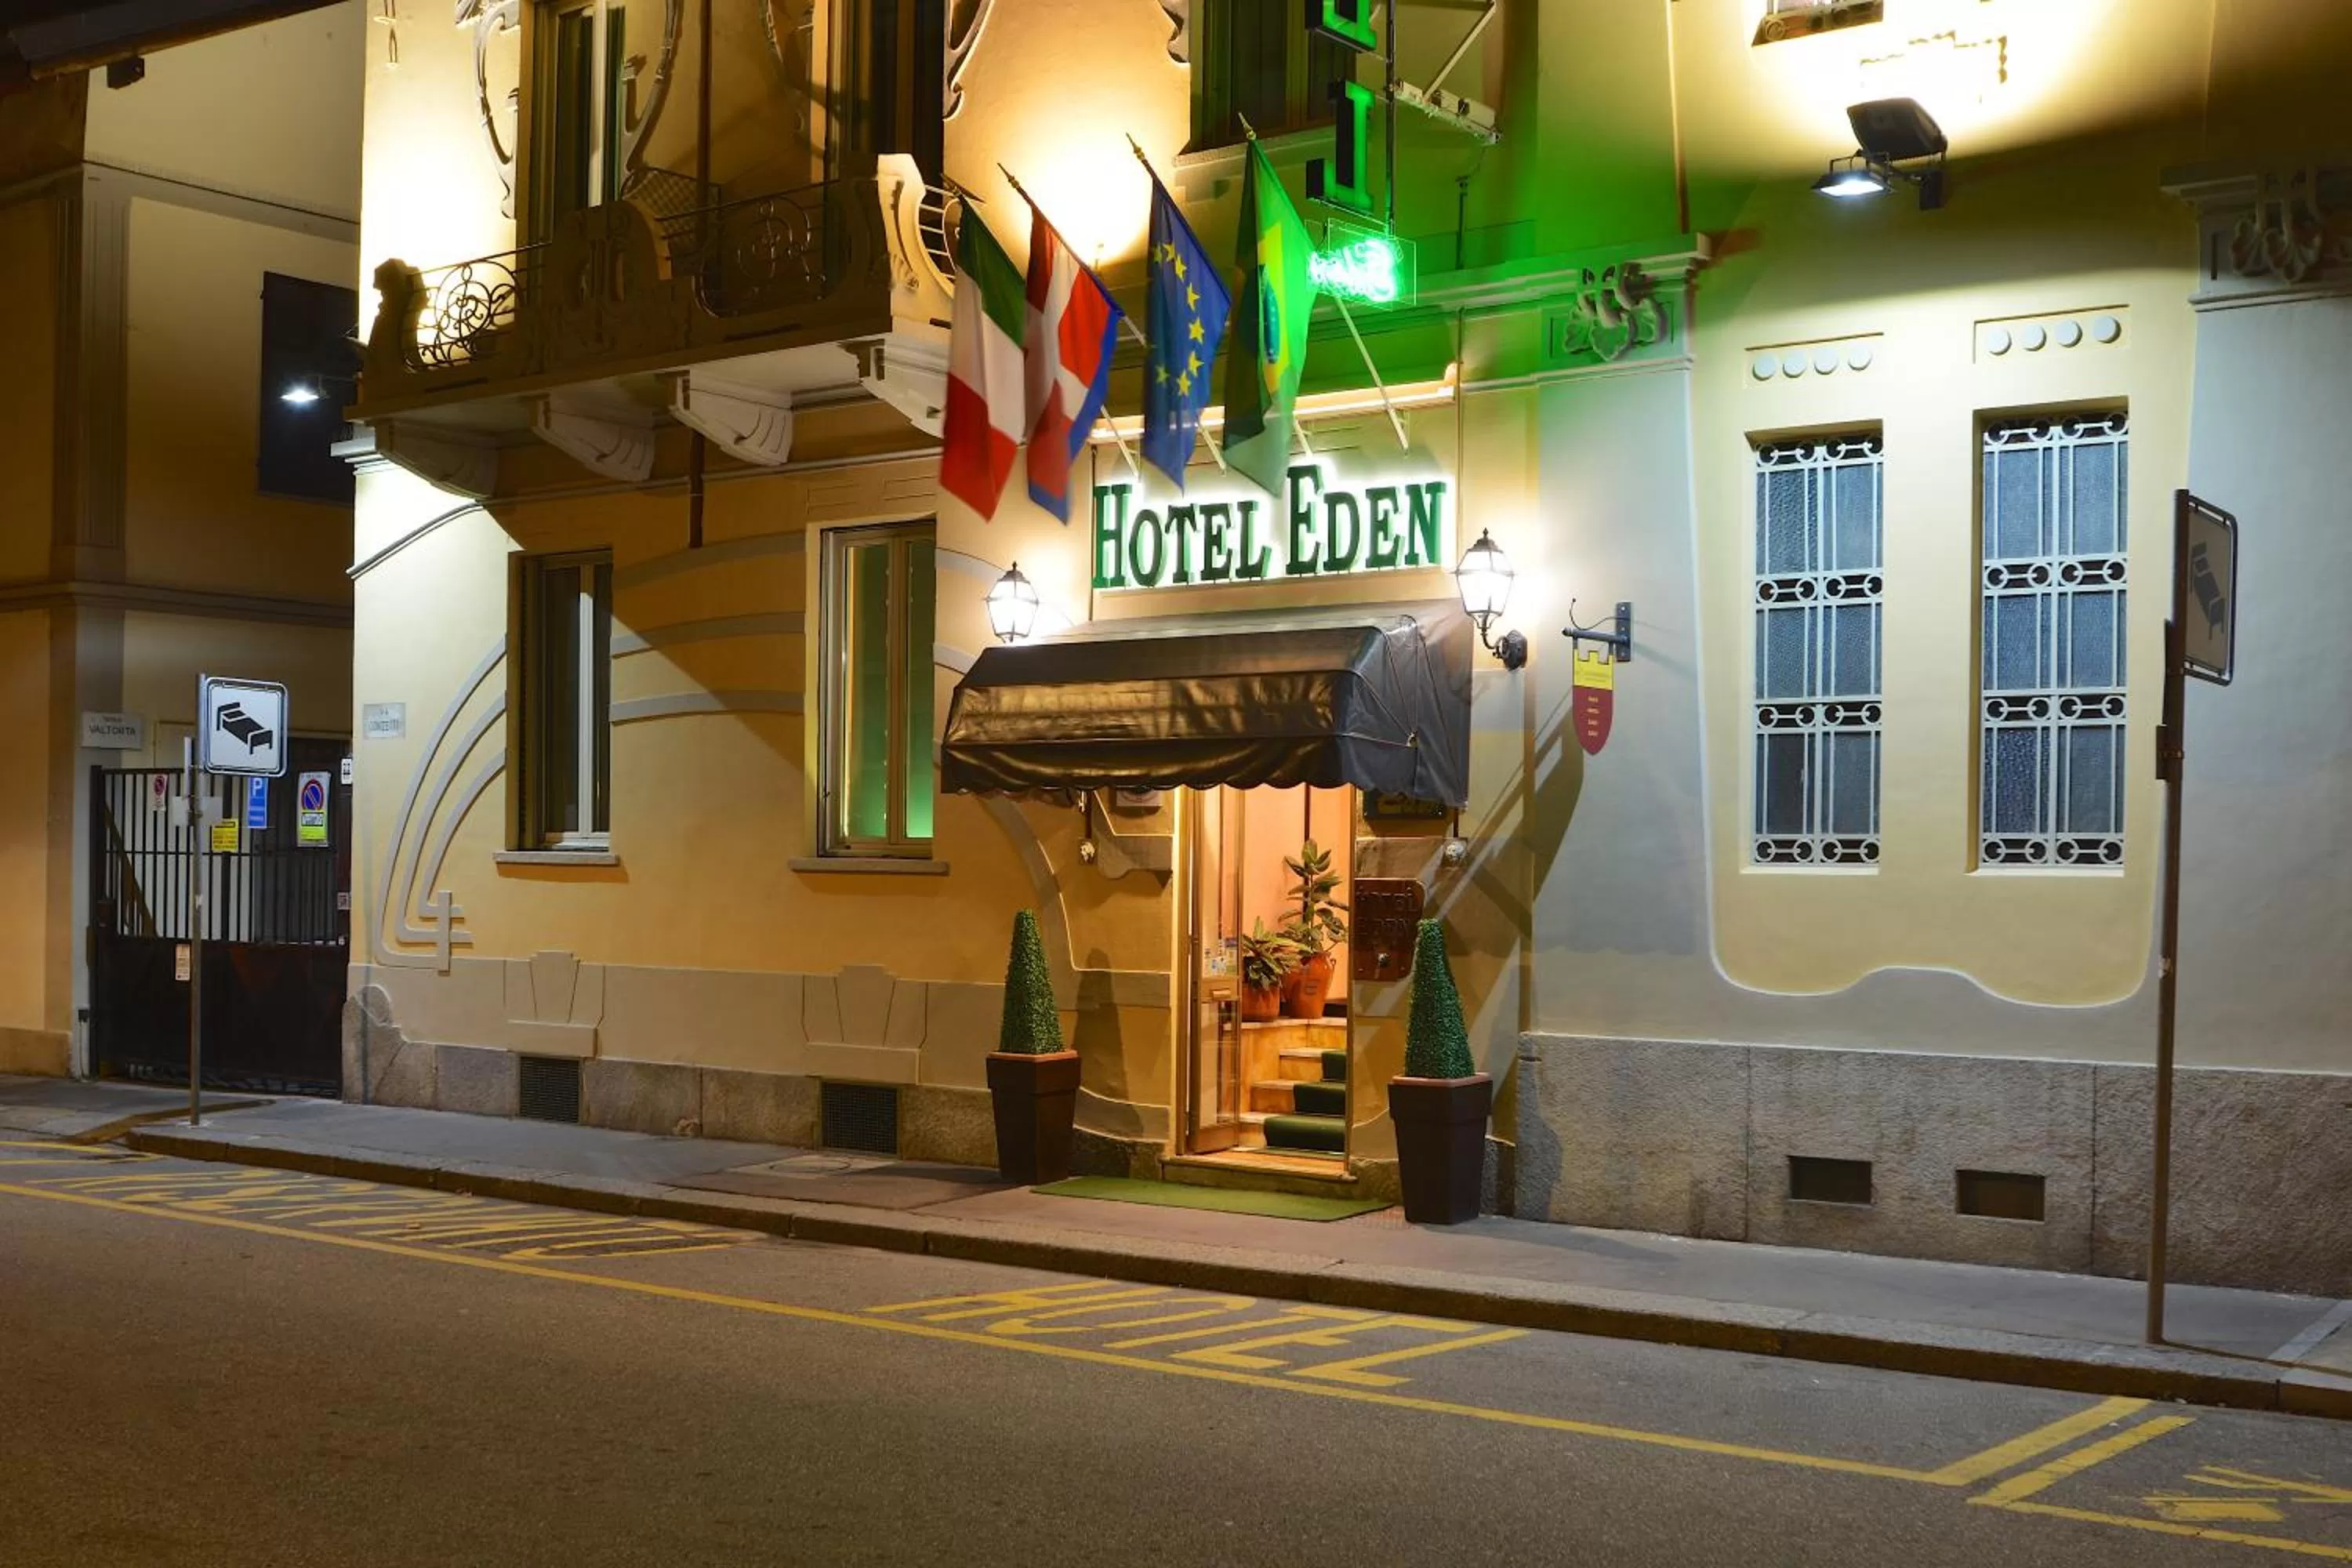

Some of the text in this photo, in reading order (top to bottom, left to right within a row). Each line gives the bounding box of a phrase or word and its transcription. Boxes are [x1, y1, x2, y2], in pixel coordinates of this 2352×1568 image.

[1093, 464, 1445, 588] HOTEL EDEN
[252, 778, 263, 796] P
[26, 1168, 766, 1260] RISERVATO
[863, 1279, 1531, 1386] HOTEL
